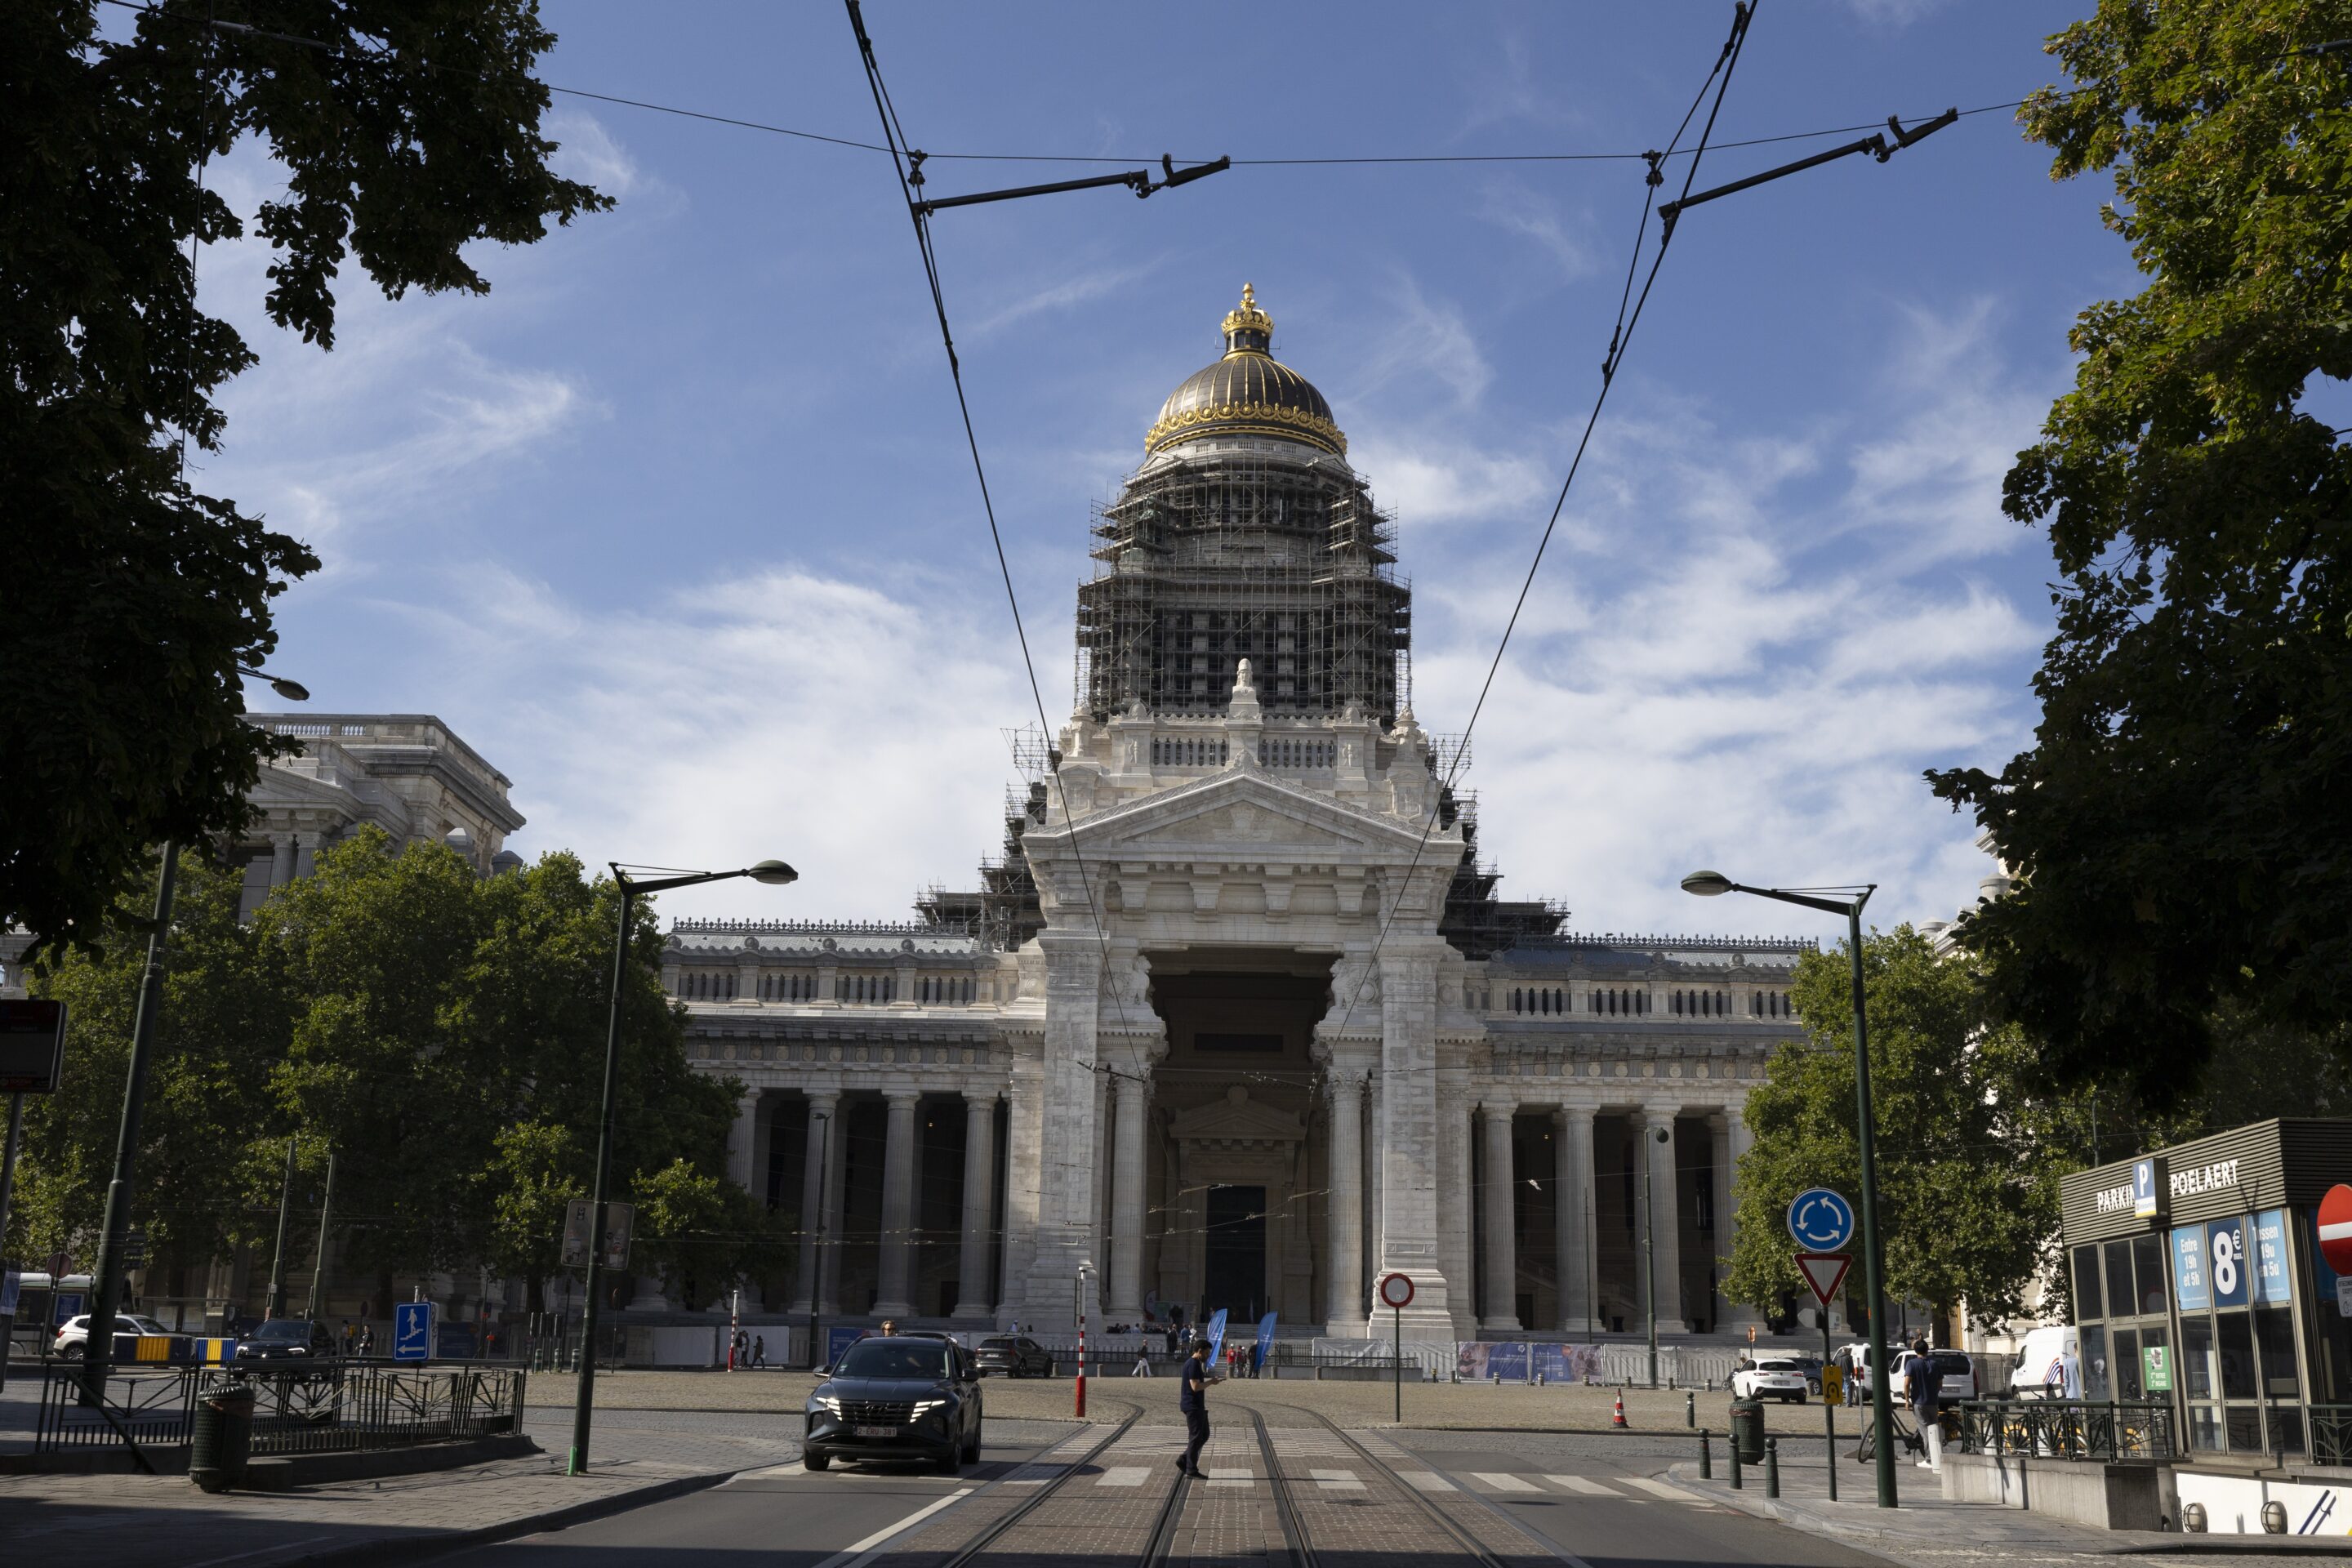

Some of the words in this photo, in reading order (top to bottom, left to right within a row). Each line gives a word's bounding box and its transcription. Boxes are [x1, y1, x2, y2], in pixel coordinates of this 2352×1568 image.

[2097, 1185, 2135, 1214] PARKIN
[2170, 1160, 2238, 1196] POELAERT
[2138, 1164, 2149, 1196] P
[2252, 1226, 2278, 1242] Tussen
[2180, 1238, 2198, 1254] Entre
[2261, 1244, 2275, 1259] 19u
[2184, 1254, 2197, 1270] 19h
[2213, 1232, 2237, 1295] 8
[2259, 1264, 2268, 1278] en
[2183, 1273, 2190, 1288] et
